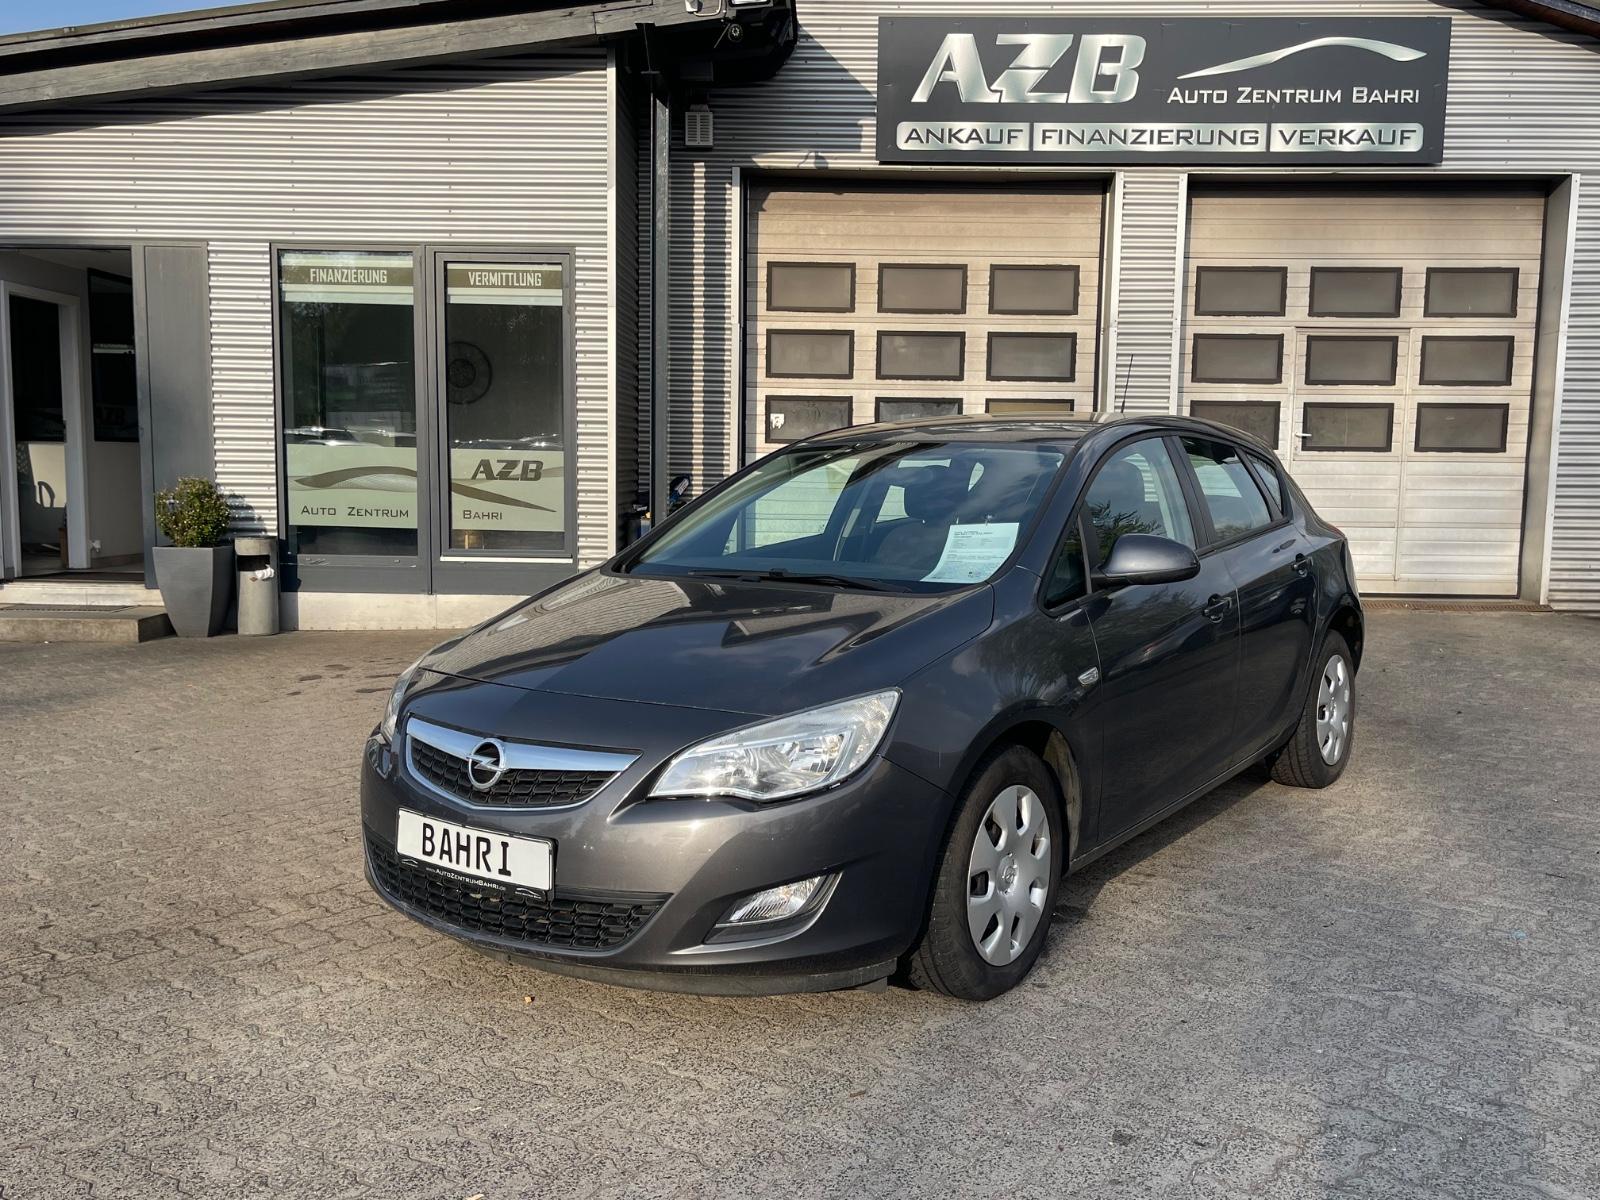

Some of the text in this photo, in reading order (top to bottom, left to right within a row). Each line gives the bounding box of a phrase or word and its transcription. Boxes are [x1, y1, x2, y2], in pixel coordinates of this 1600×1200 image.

[911, 33, 1147, 103] AZB
[904, 128, 1418, 147] ANKAUF FINANZIERUNG VERKAUF
[309, 268, 388, 284] FINANZIERUNG
[468, 271, 542, 287] VERMITTLUNG
[471, 459, 544, 482] AZB
[422, 822, 512, 877] BAHRI
